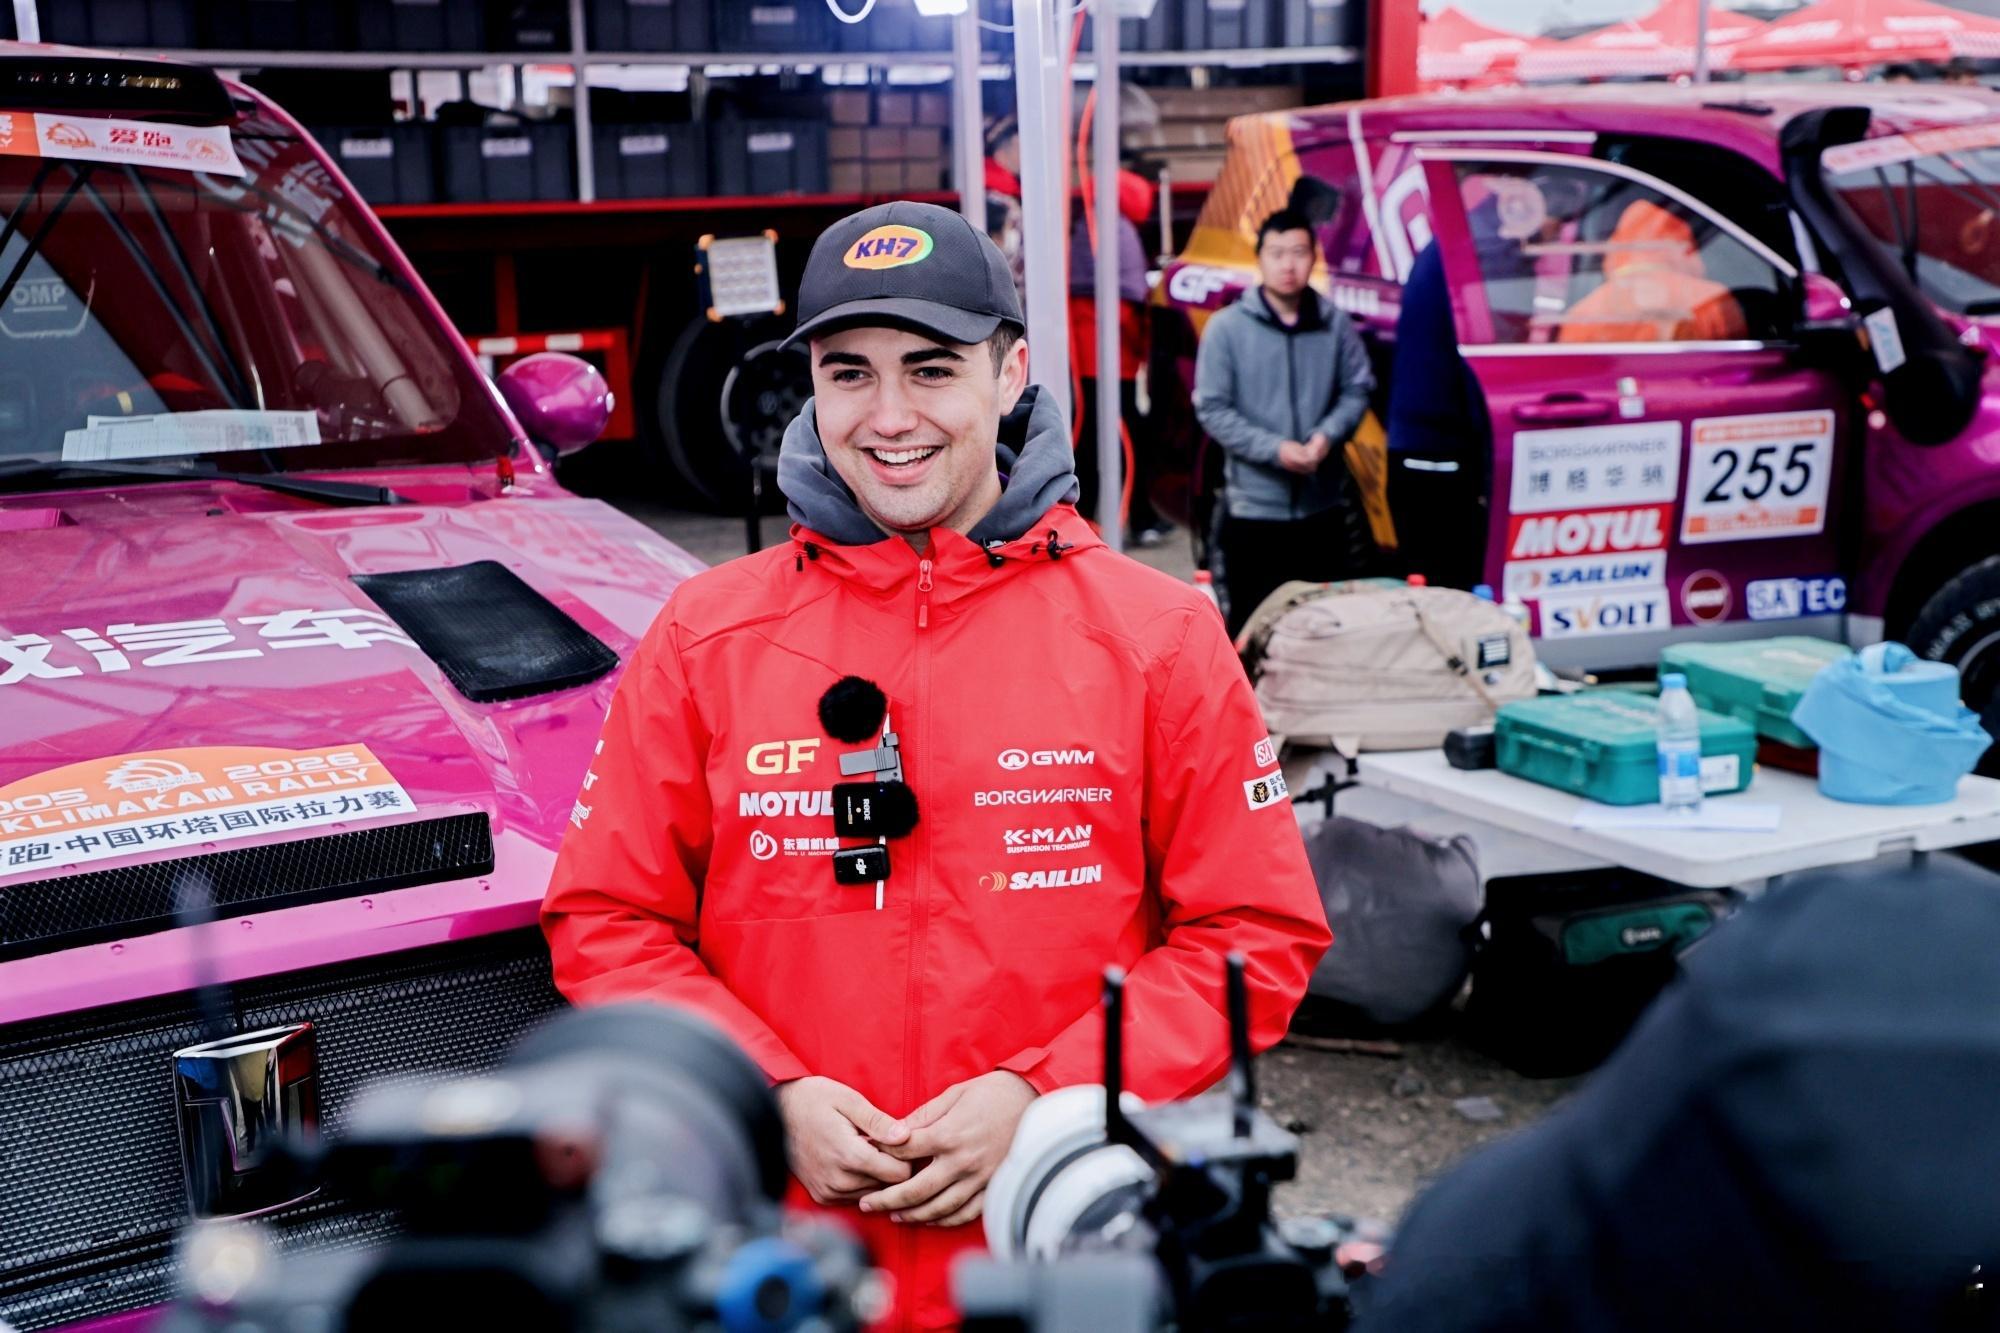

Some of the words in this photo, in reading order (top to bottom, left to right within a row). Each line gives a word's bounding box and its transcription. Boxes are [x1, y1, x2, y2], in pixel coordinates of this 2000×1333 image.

[12, 284, 66, 306] OMP
[1703, 444, 1816, 502] 255
[1511, 508, 1665, 558] MOTUL
[1548, 562, 1653, 586] SAILUN
[1750, 578, 1846, 616] SATEC
[1553, 601, 1657, 630] SVOLT
[222, 752, 360, 781] 2026
[746, 738, 821, 775] GF
[1031, 750, 1095, 766] GWM
[0, 786, 233, 836] KLIMAKAN
[241, 767, 369, 797] RALLY
[739, 790, 834, 817] MOTUL
[974, 787, 1113, 806] BORGWARNER
[0, 790, 401, 866] 跑·中国环塔国际拉力赛
[1003, 824, 1092, 846] K-MAN
[1007, 844, 1050, 854] SUSPENSION
[1052, 840, 1090, 852] TECHNOLOGY
[1009, 864, 1102, 890] SAILUN
